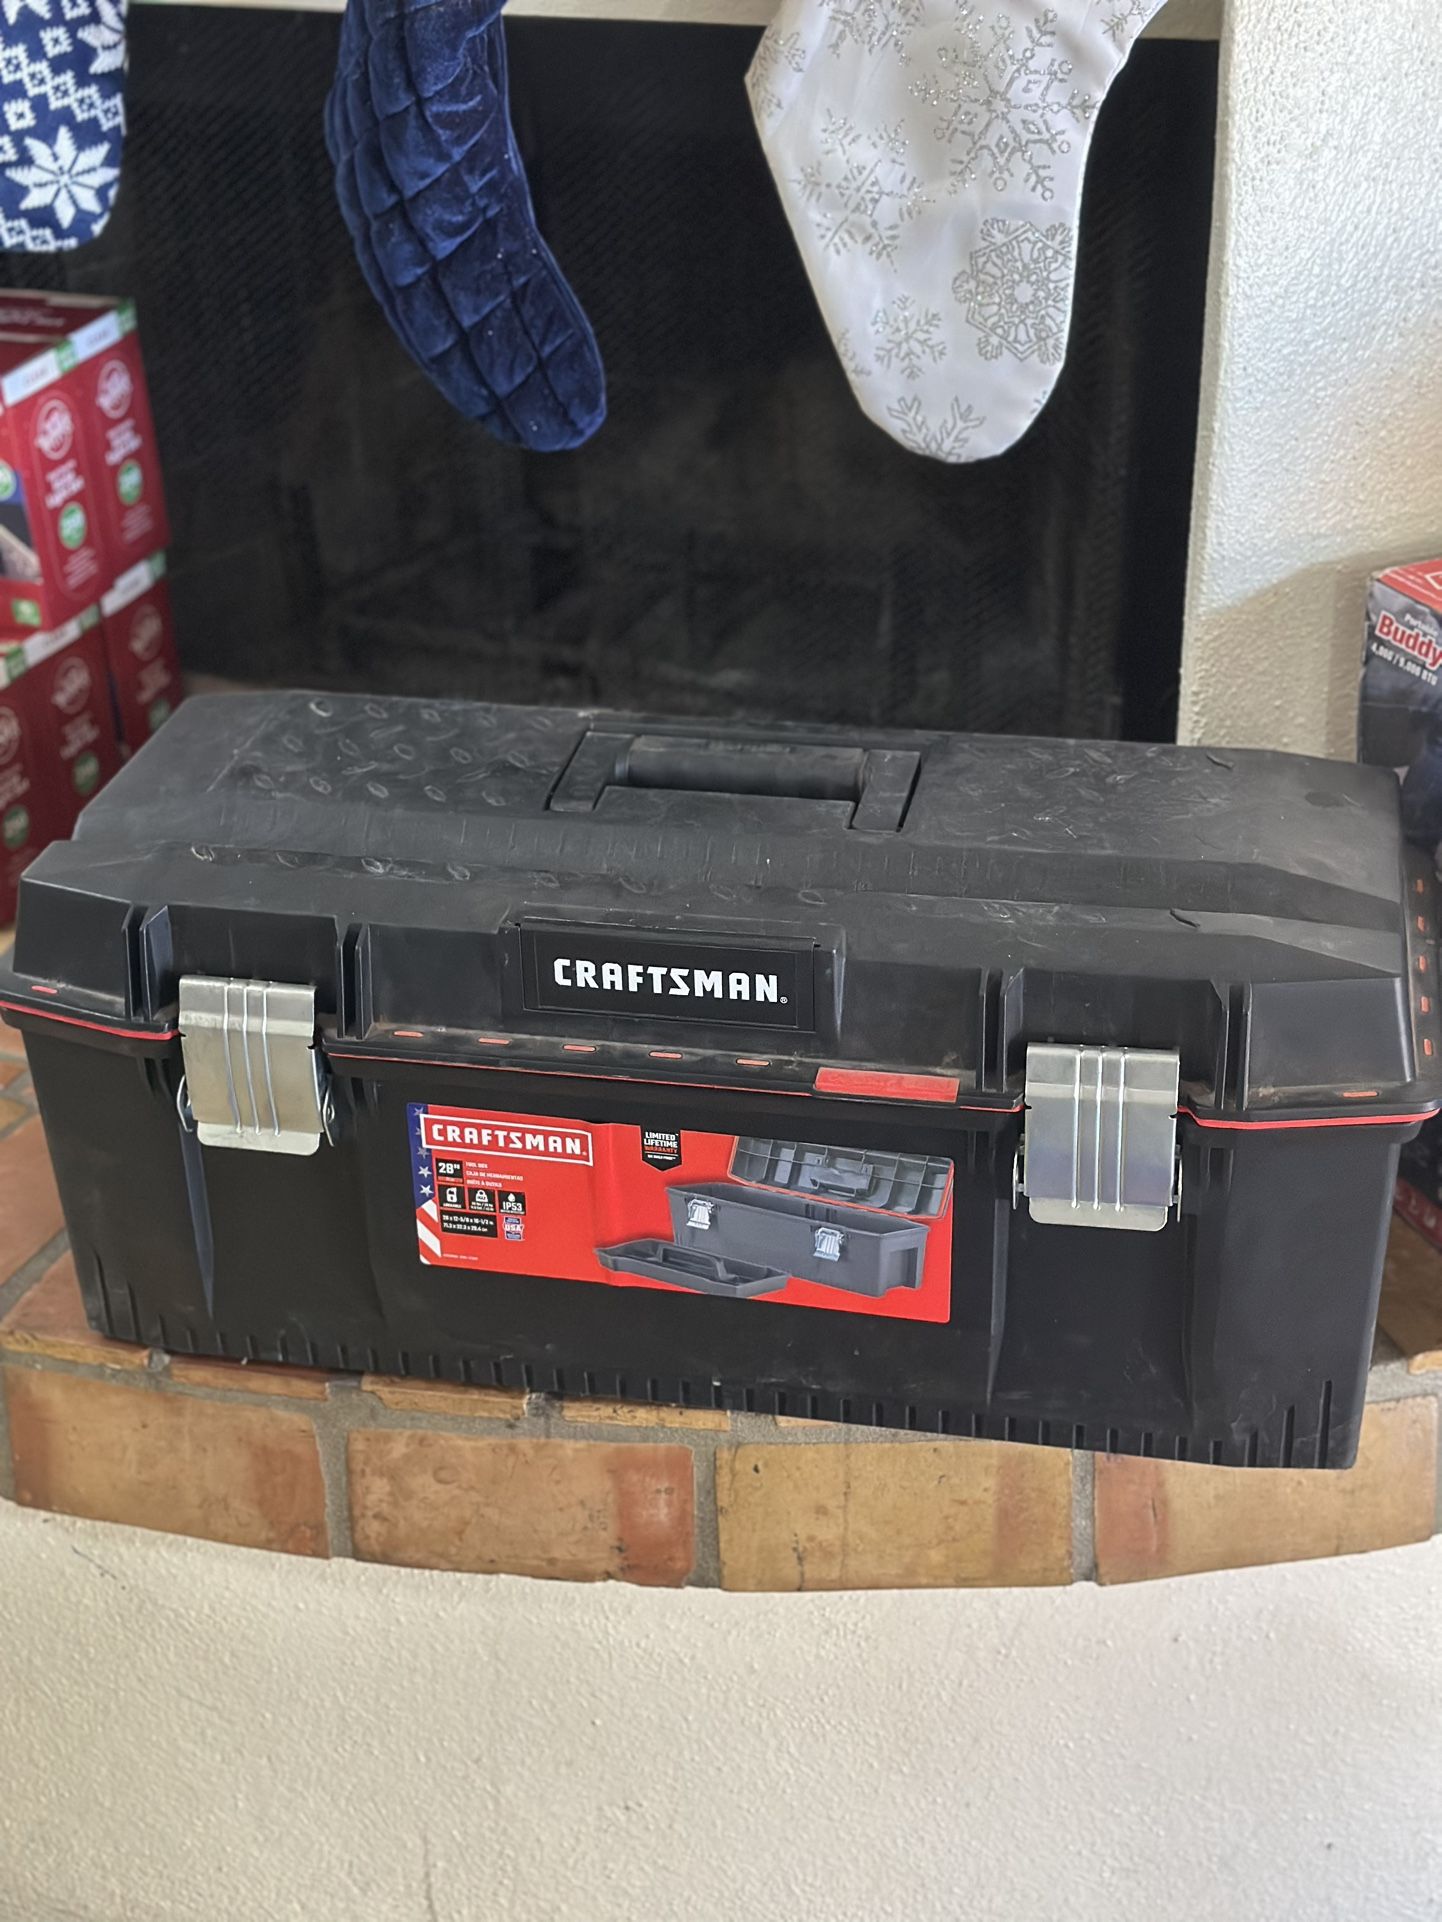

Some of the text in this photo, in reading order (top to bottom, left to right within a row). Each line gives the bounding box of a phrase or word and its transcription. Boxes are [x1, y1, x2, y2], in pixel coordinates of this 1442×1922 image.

[1375, 610, 1442, 671] Buddy
[645, 1131, 676, 1141] LIMITED
[644, 1138, 678, 1148] LIFETIME
[502, 1201, 523, 1212] IP53
